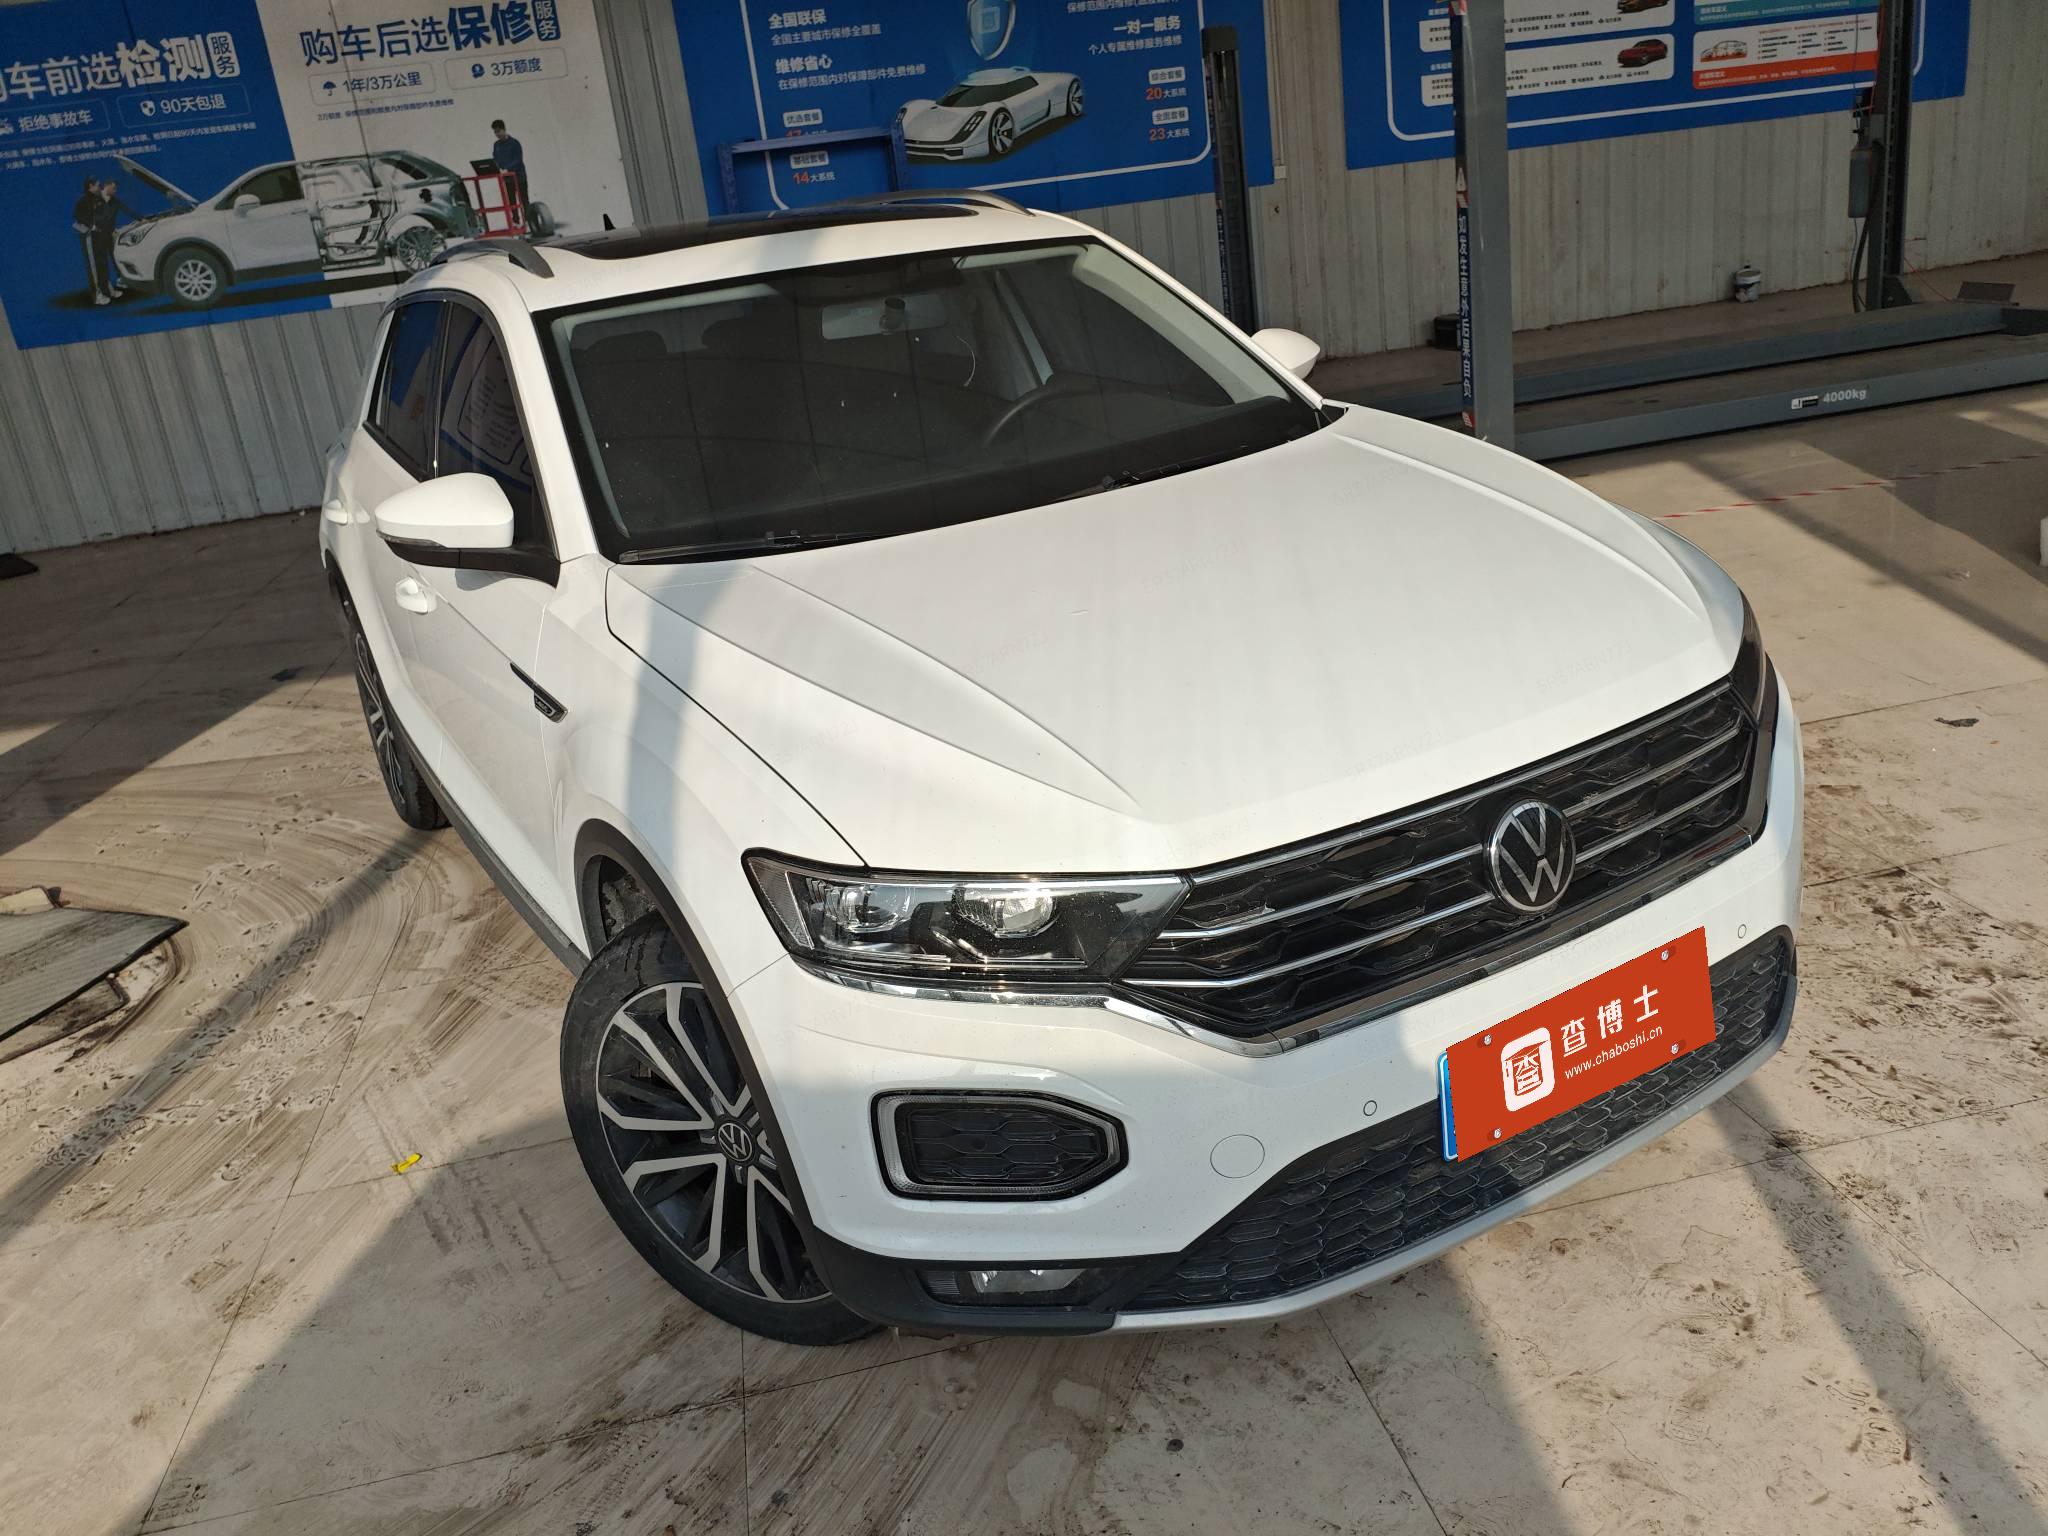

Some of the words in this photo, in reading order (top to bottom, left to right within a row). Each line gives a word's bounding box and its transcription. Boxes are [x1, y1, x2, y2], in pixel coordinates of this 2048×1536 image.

[768, 8, 826, 29] 全国联保
[1113, 15, 1181, 34] 一对一服务
[300, 1, 535, 67] 购车后选保修
[772, 24, 882, 46] 全国主要城市保修全覆盖
[211, 34, 236, 76] 服务
[775, 54, 832, 74] 维修省心
[0, 34, 212, 102] 车前选检测
[490, 58, 542, 77] 3万额度
[342, 72, 423, 93] 1年/3万公里
[160, 93, 227, 114] 90天包退
[1145, 87, 1187, 100] 20大系统
[18, 109, 94, 132] 拒绝事故车
[1149, 128, 1190, 141] 23大系统
[793, 171, 836, 184] 14大系统
[1823, 388, 1867, 403] 4000kg
